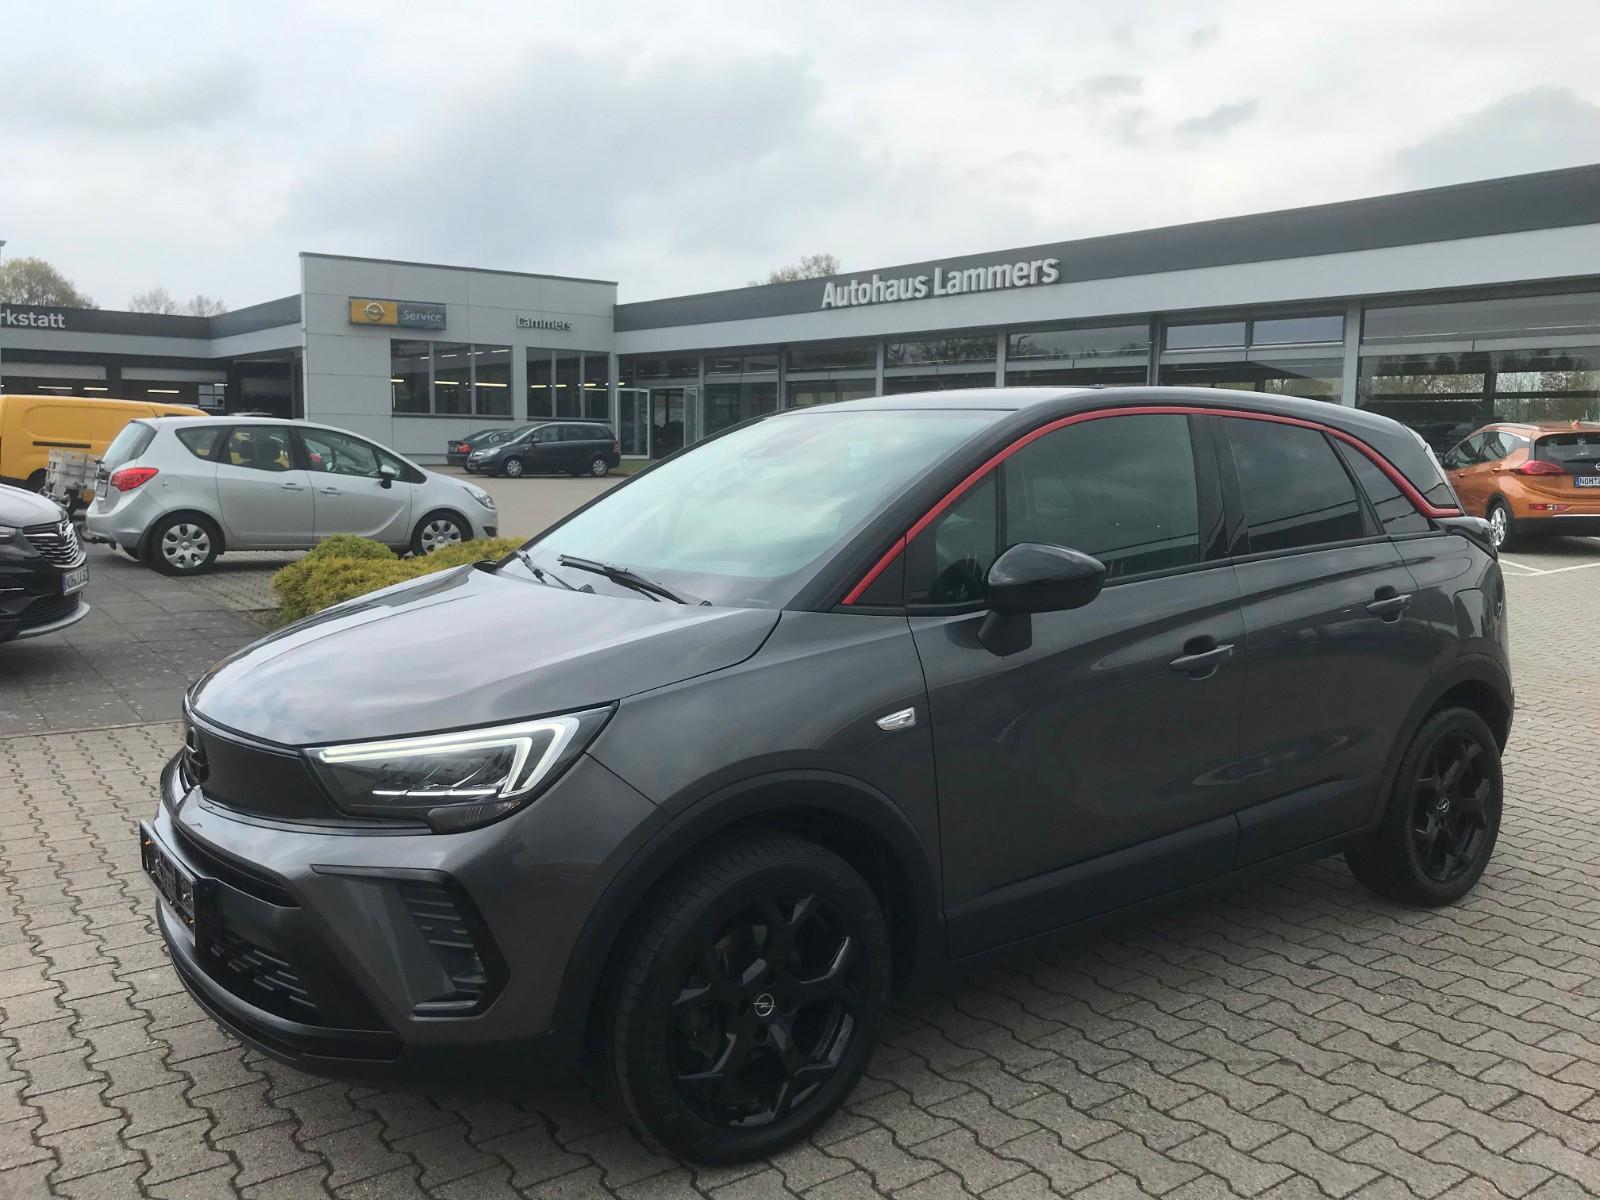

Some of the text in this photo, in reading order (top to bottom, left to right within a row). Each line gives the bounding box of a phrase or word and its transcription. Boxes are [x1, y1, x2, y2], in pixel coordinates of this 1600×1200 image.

[821, 257, 1061, 309] Autohaus Lammers
[402, 310, 442, 322] Service
[516, 313, 574, 331] Lammers
